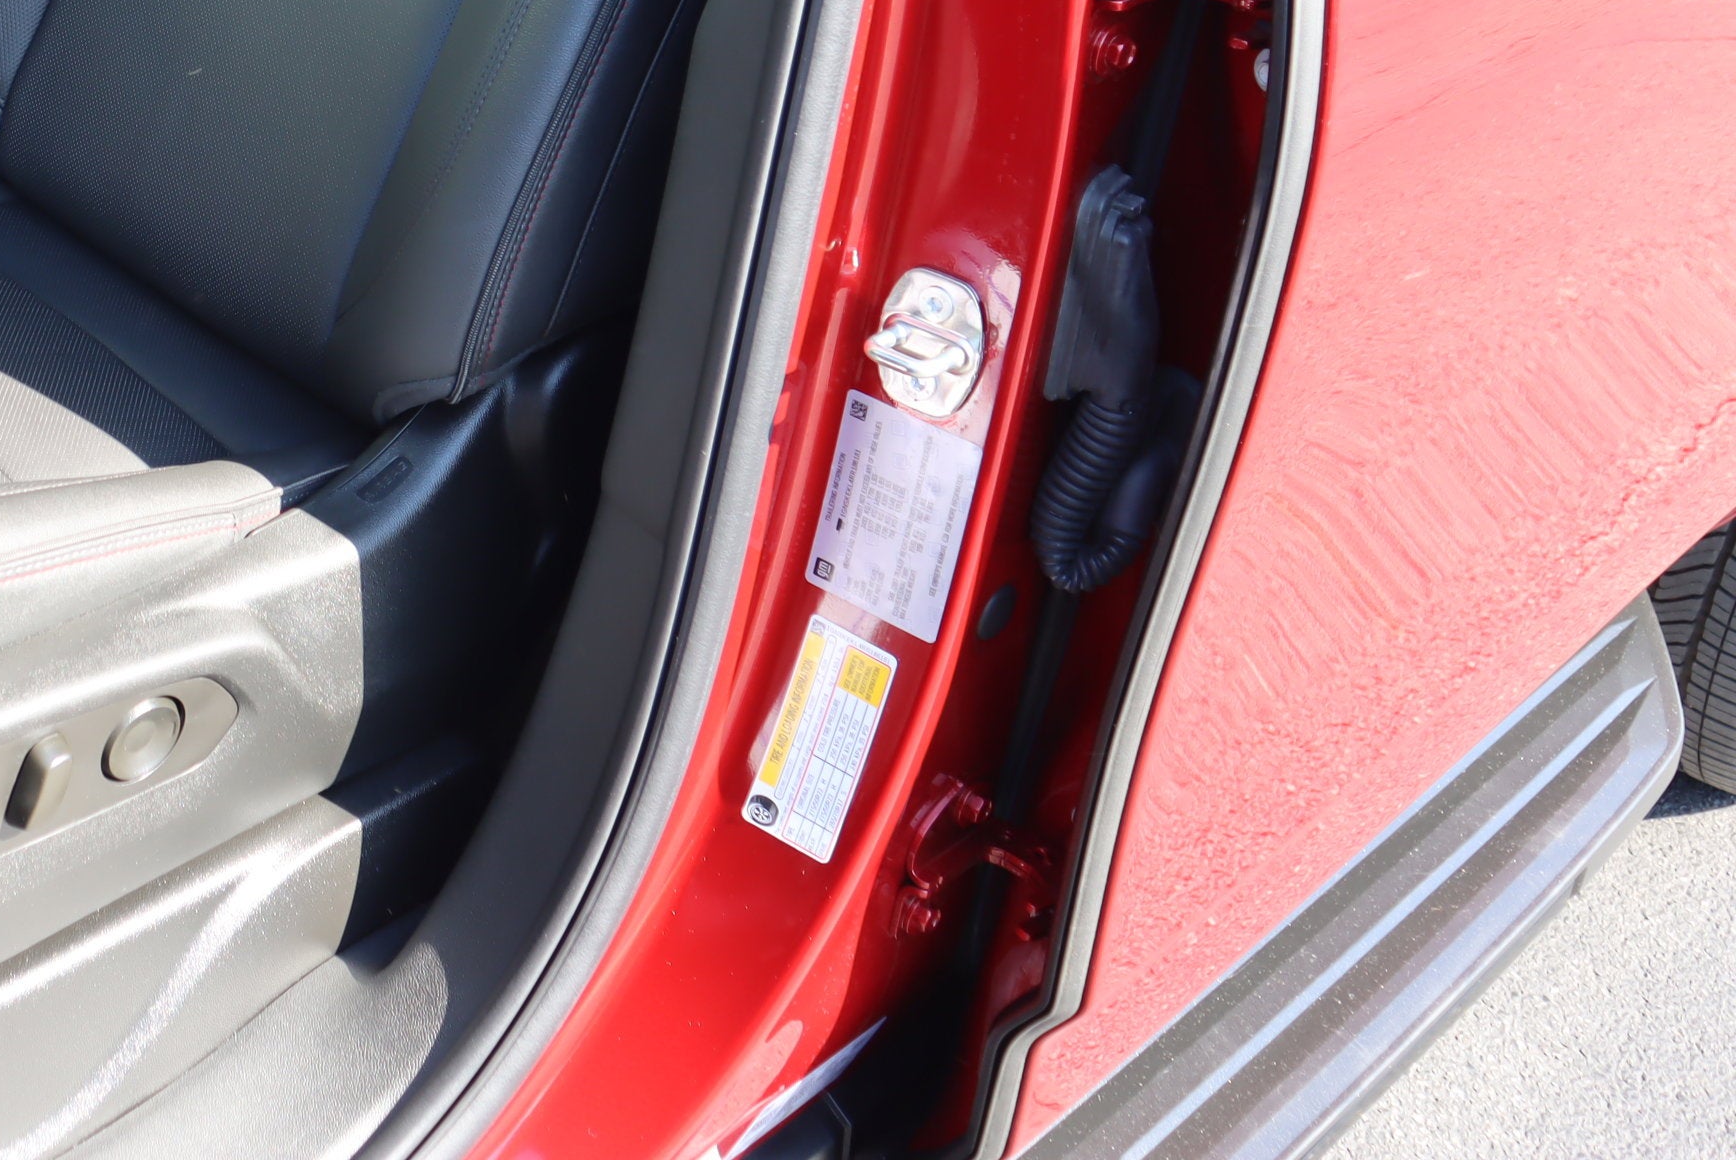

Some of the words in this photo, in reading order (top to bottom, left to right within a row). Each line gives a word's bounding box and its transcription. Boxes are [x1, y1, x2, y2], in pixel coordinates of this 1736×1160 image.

[824, 489, 838, 522] TRAILERING
[831, 451, 846, 490] INFORMATION
[815, 560, 831, 580] gm
[789, 656, 815, 705] INFORMATION
[779, 701, 800, 736] LOADING
[774, 731, 789, 750] AND
[768, 747, 783, 766] TIRE
